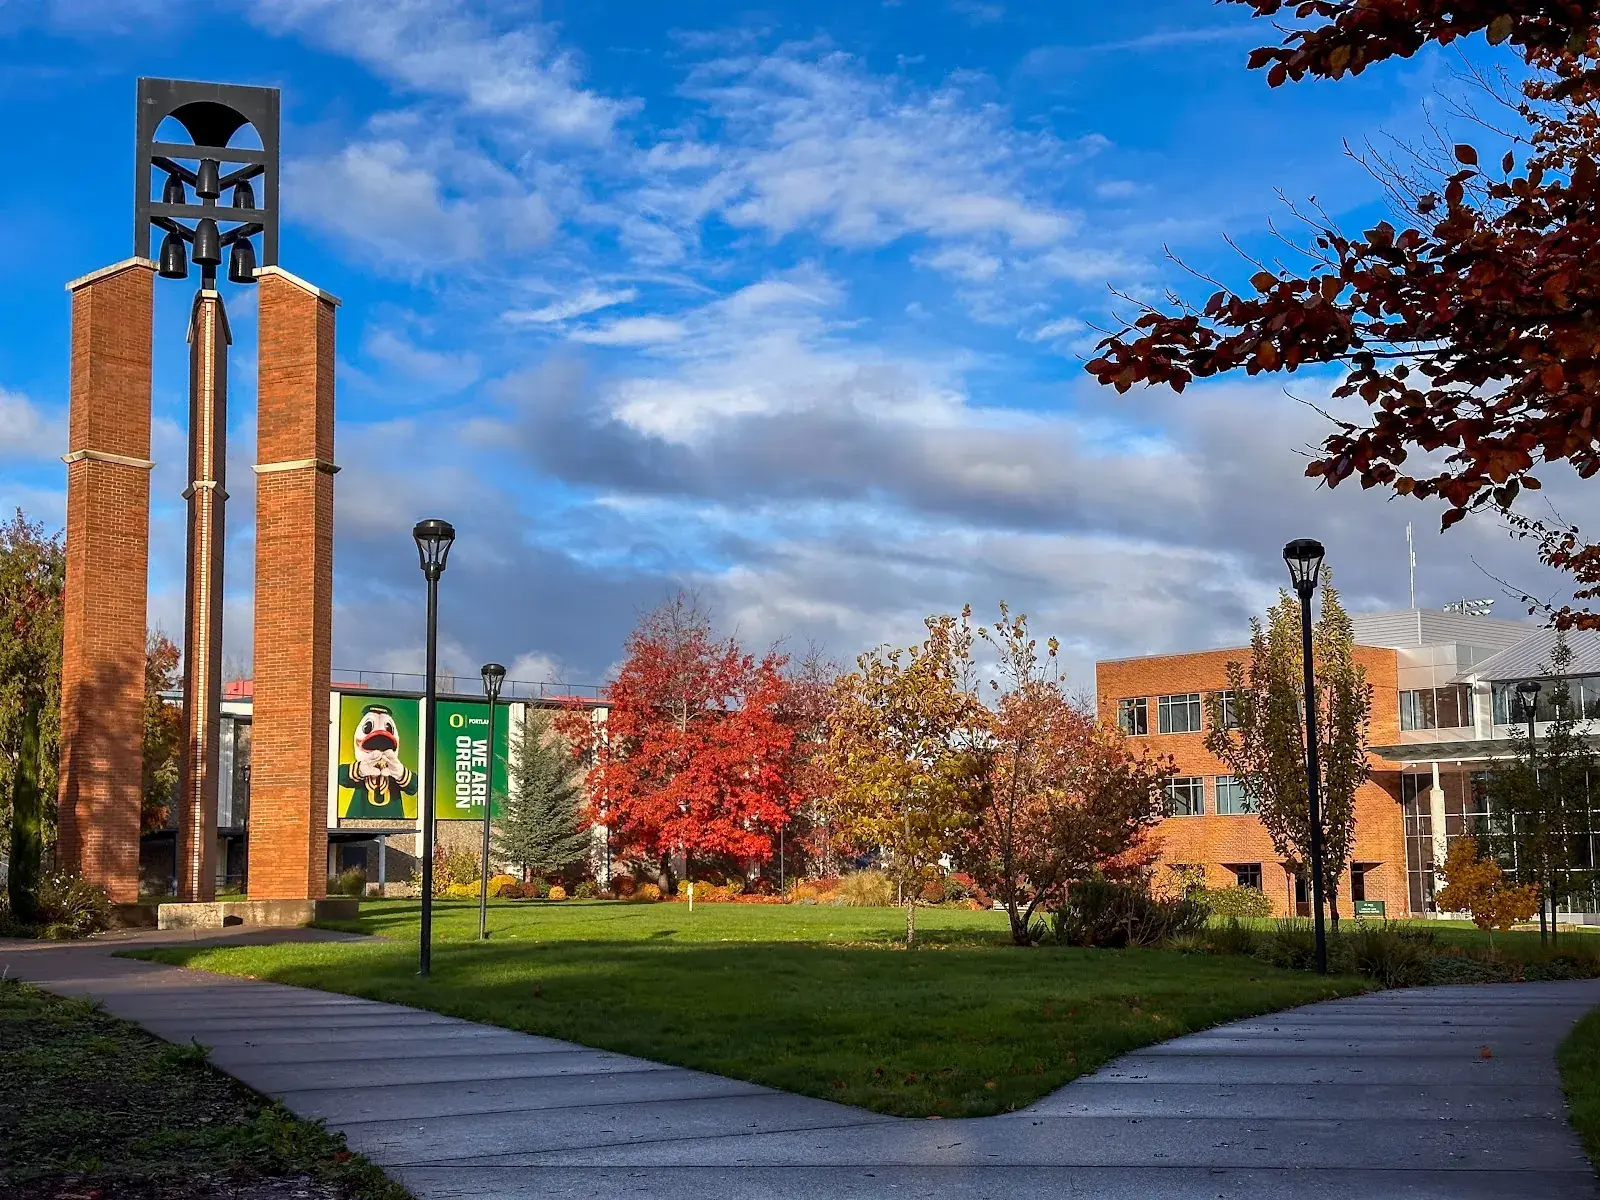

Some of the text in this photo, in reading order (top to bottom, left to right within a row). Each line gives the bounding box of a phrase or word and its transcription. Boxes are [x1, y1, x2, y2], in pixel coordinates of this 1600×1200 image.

[449, 713, 464, 728] O
[455, 735, 472, 809] OREGON
[471, 739, 488, 806] WE ARE
